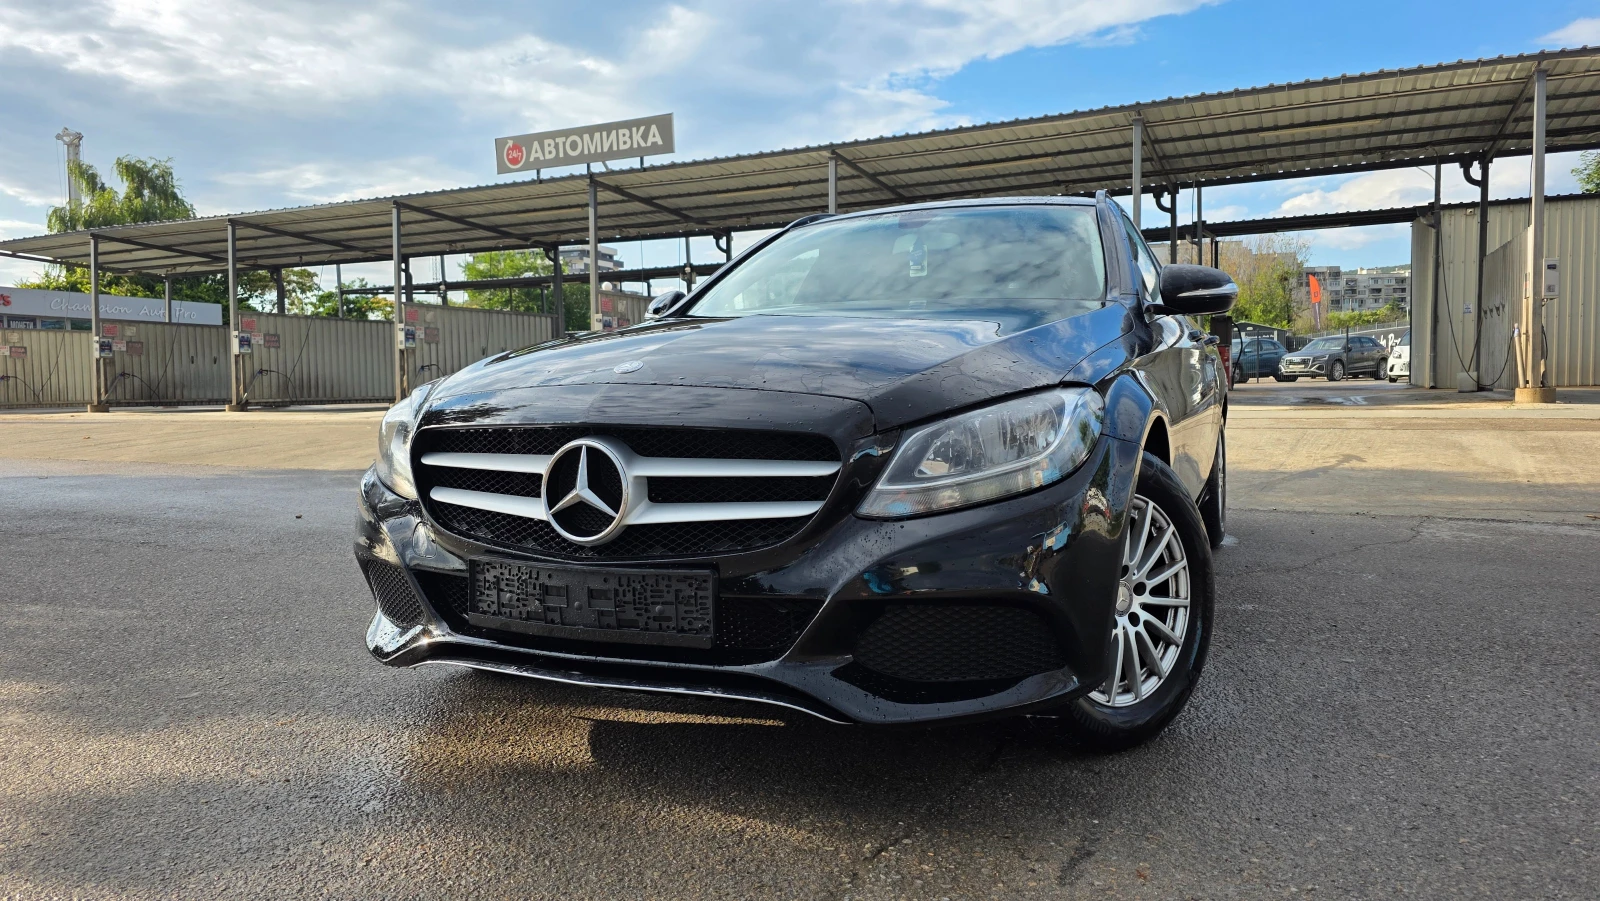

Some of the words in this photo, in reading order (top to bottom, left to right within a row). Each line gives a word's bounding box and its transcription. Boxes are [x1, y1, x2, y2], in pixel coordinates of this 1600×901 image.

[508, 149, 522, 161] 24/7
[529, 124, 663, 162] АВТОМИВКА
[139, 305, 167, 319] Aut
[175, 307, 197, 319] Pro
